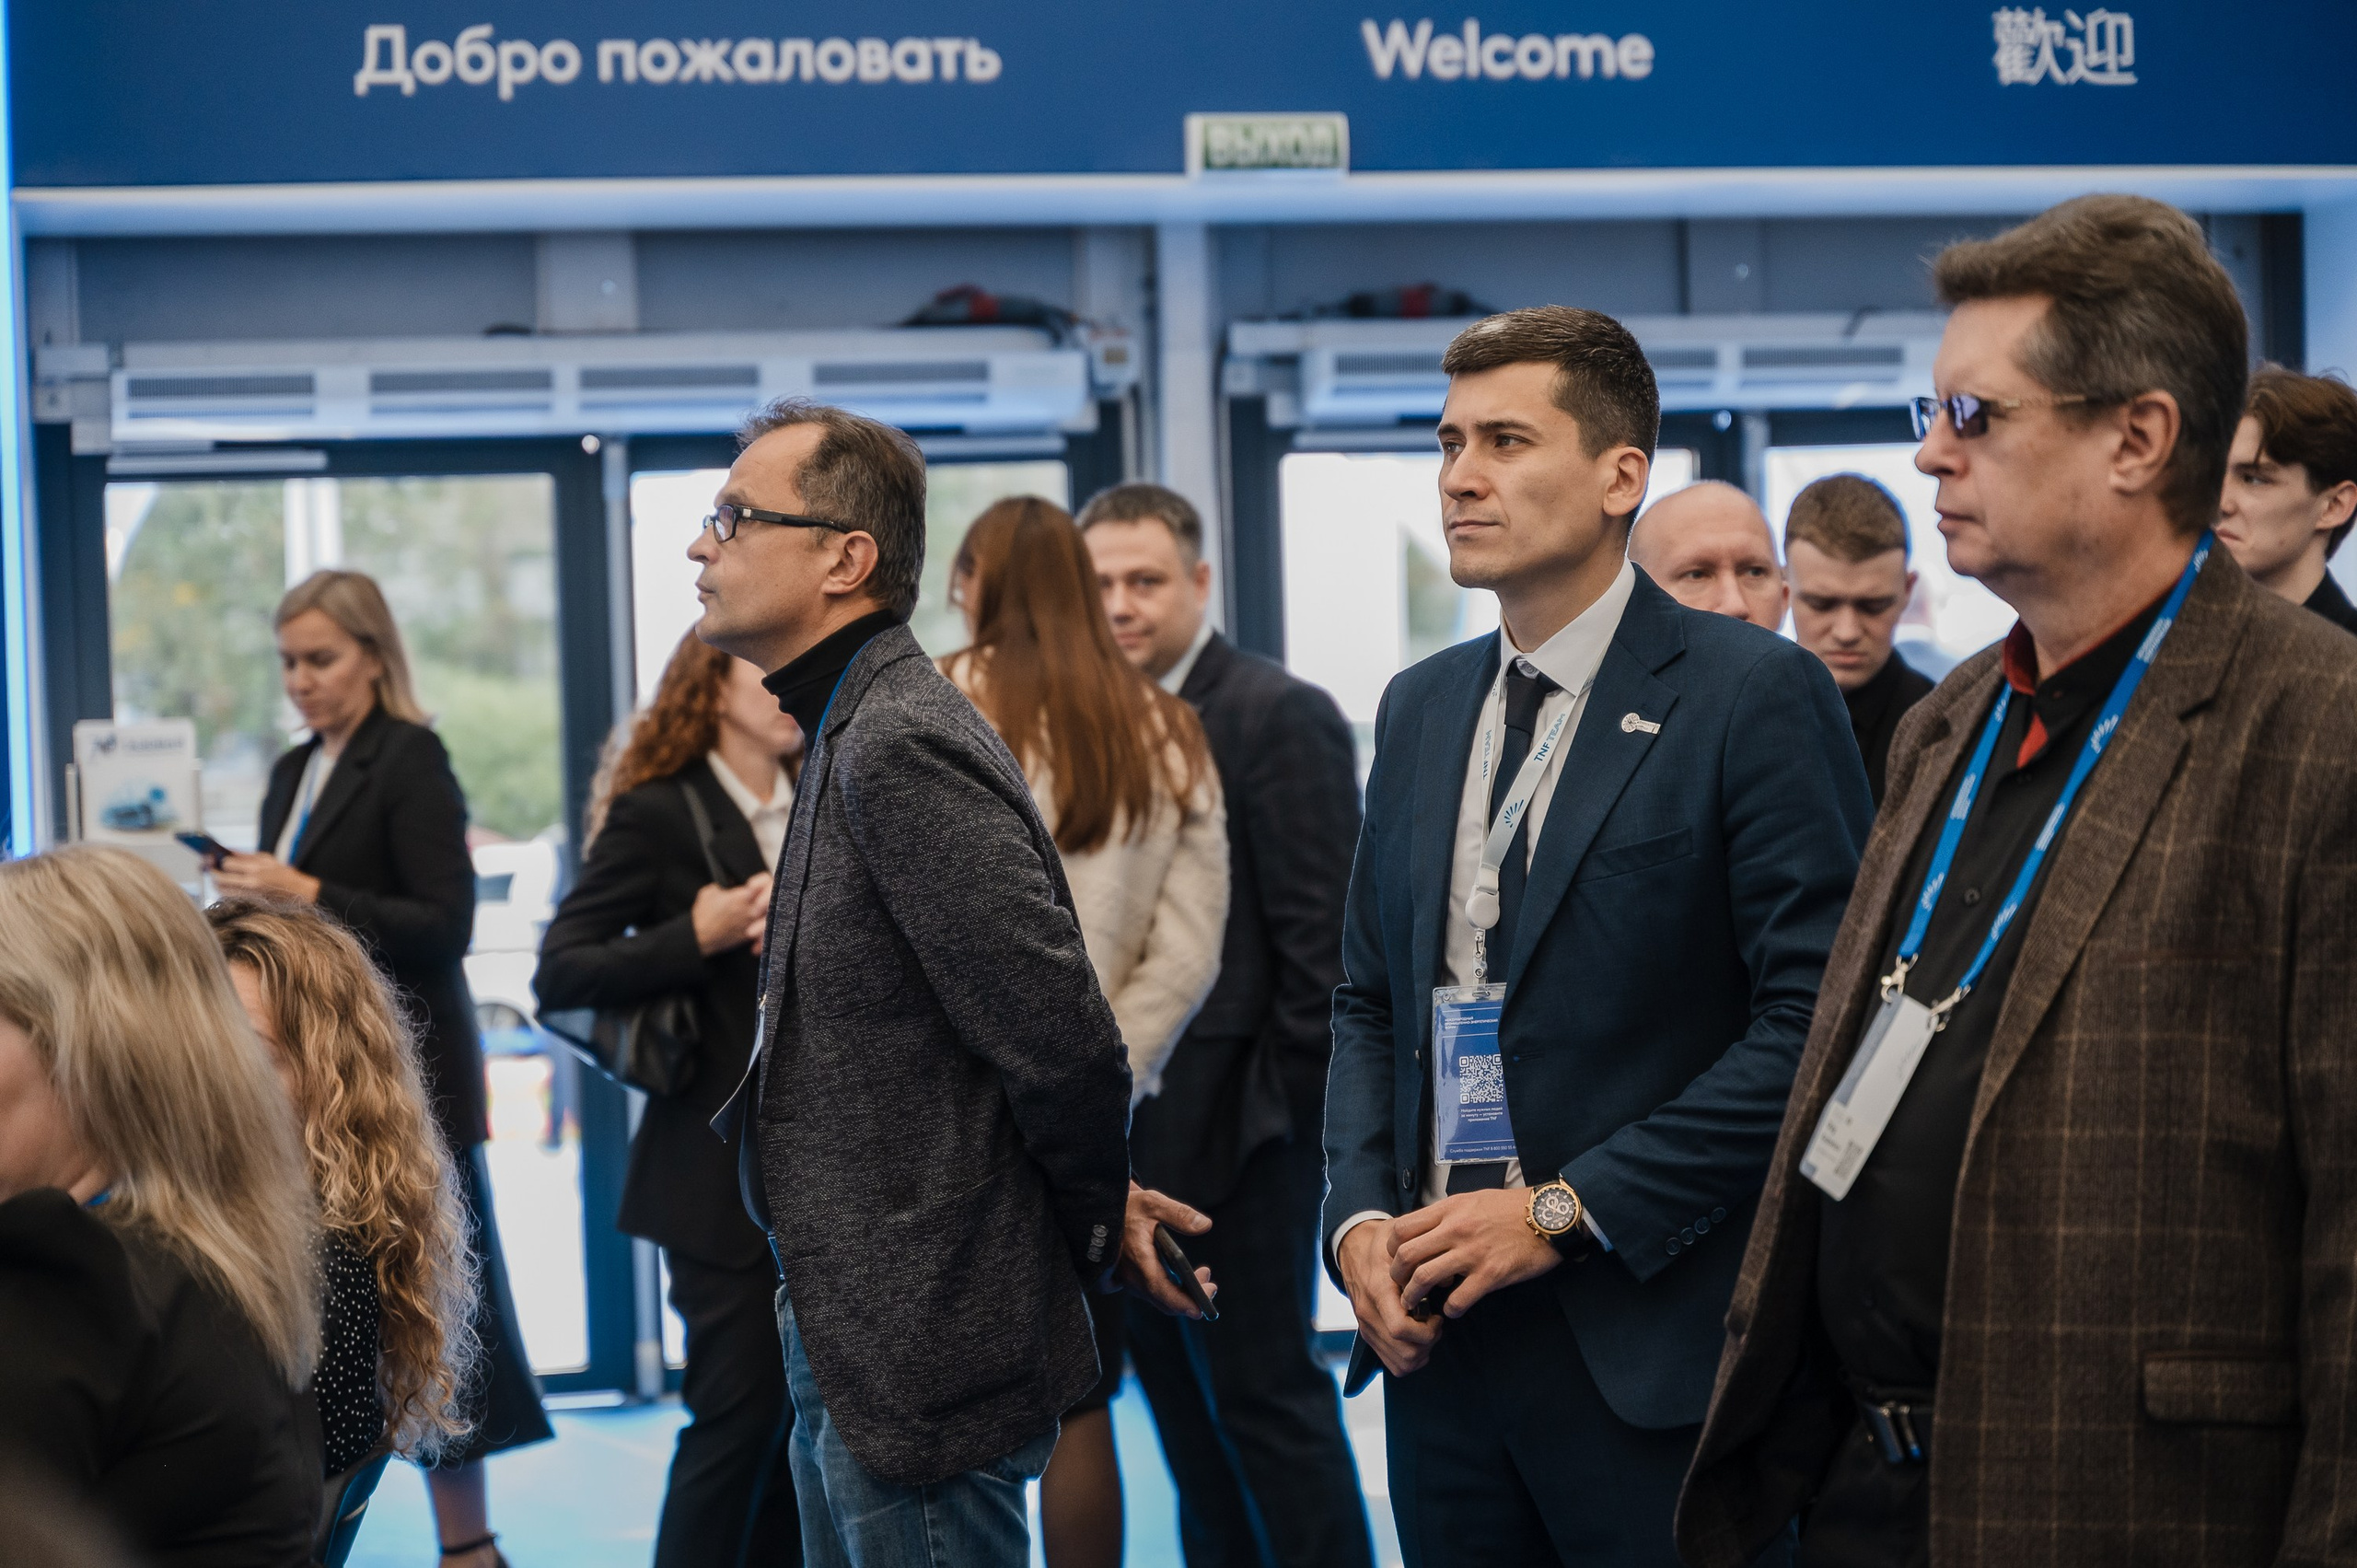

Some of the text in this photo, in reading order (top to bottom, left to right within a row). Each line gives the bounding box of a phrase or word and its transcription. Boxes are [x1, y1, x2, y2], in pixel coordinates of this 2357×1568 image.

[354, 24, 1002, 100] Добро пожаловать
[1361, 18, 1654, 80] Welcome
[1991, 6, 2139, 87] 歡迎
[1534, 714, 1565, 761] TNF TEAM
